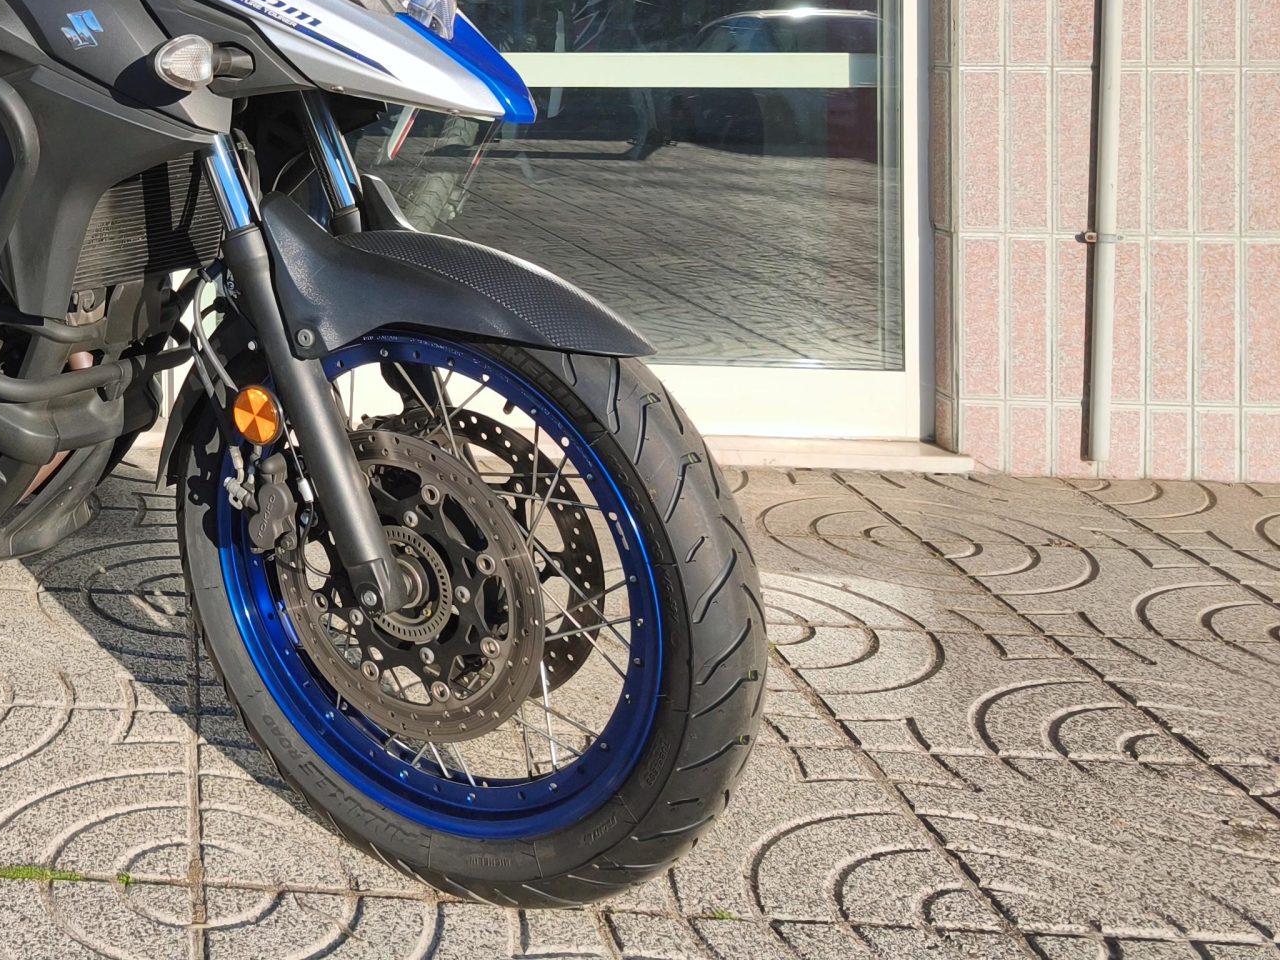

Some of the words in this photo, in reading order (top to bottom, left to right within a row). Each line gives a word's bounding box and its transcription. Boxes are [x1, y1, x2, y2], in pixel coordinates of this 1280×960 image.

[262, 7, 298, 29] TOURER
[257, 494, 276, 540] TOKICO
[262, 714, 304, 761] ROAD
